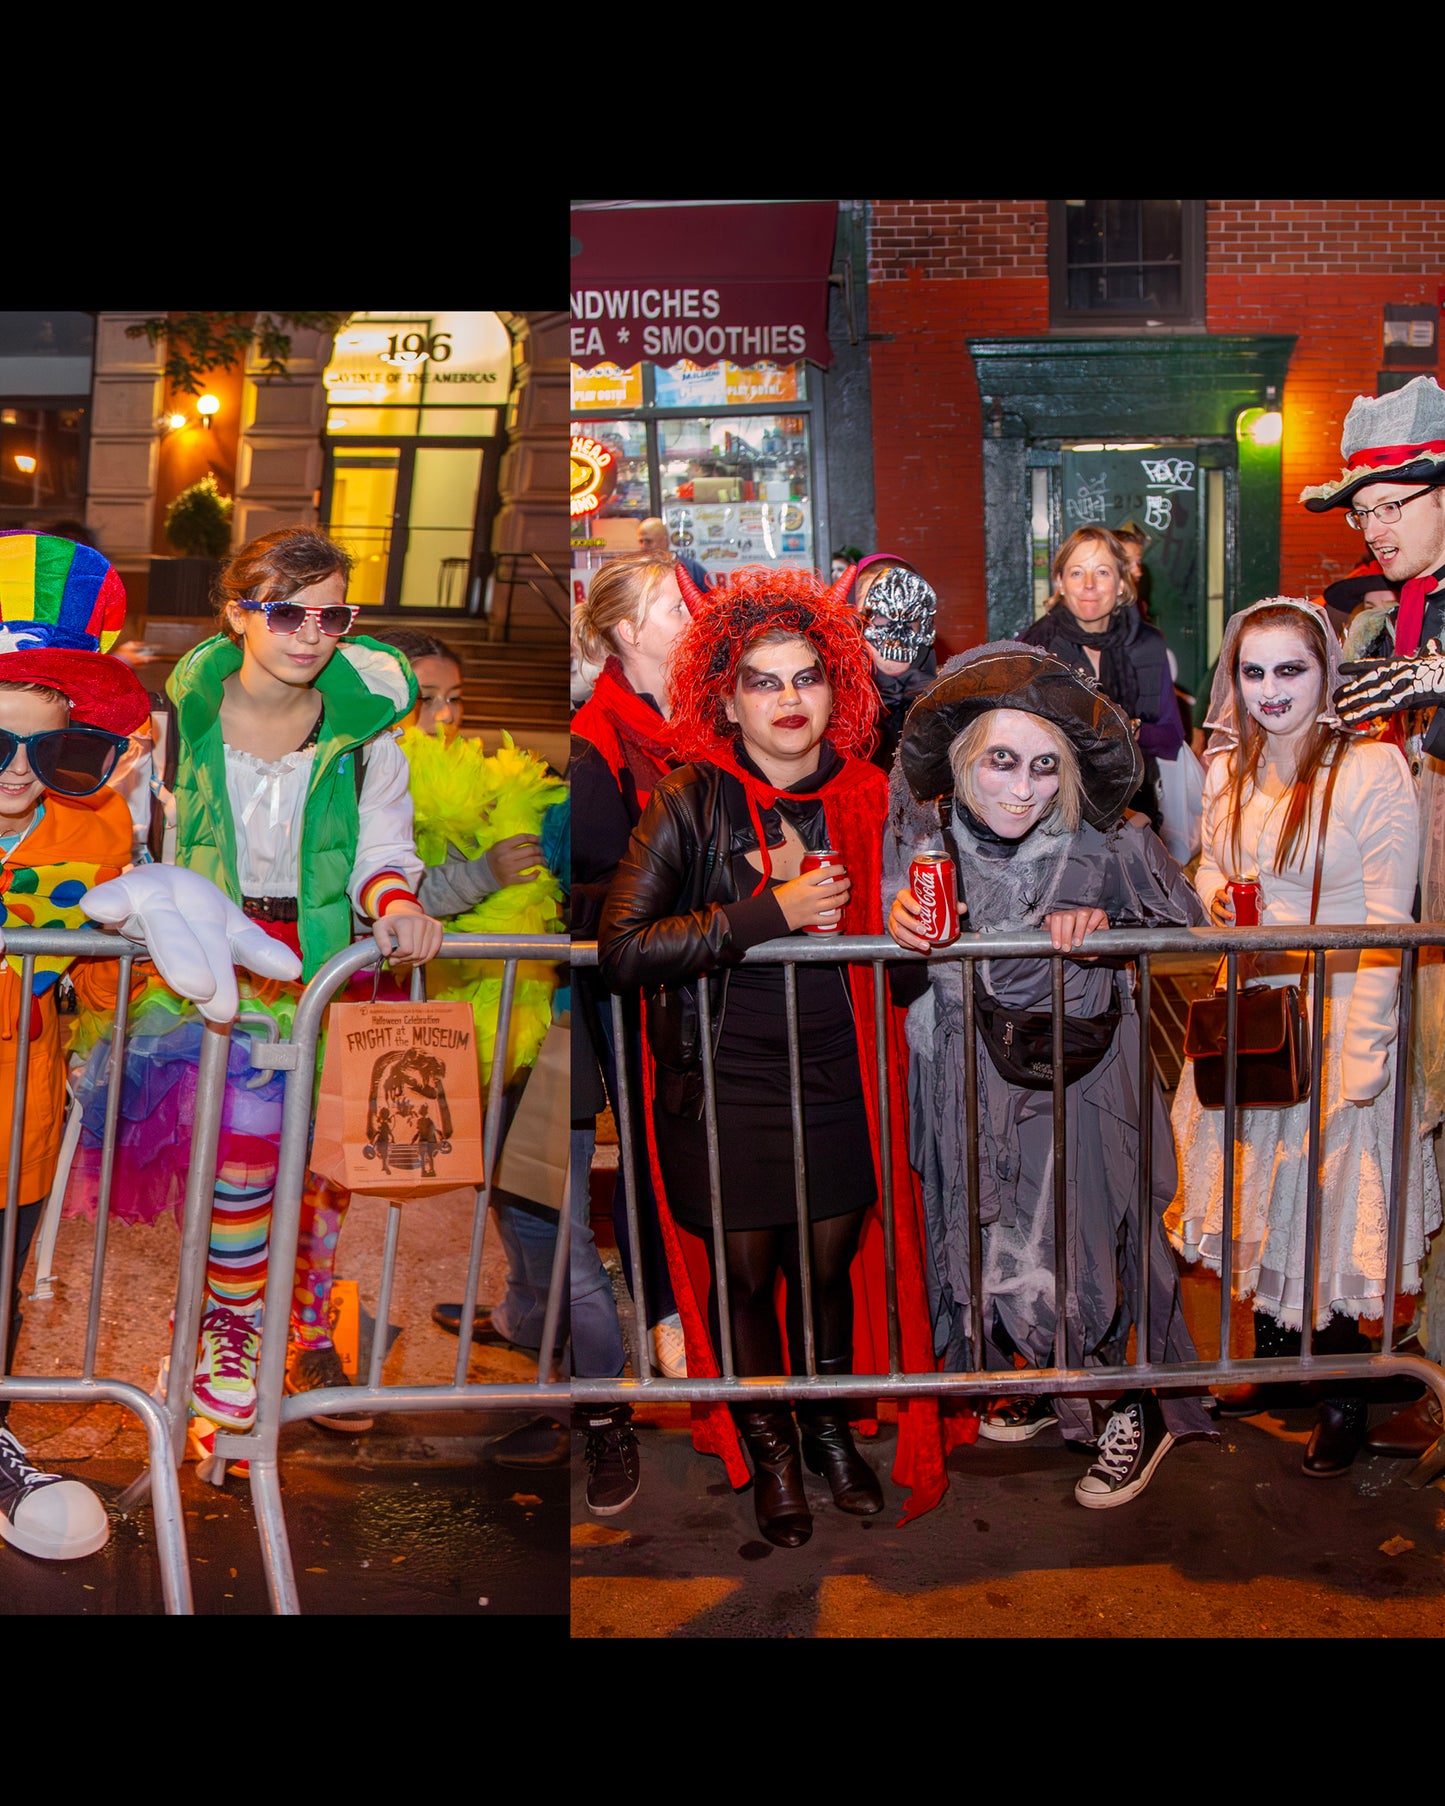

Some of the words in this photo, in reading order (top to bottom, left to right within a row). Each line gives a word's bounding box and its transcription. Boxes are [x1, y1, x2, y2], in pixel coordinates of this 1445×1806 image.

[387, 333, 452, 362] 196
[643, 325, 806, 355] SMOOTHIES
[385, 373, 402, 384] OF
[407, 373, 429, 384] THE
[434, 373, 497, 384] AMERICAS
[572, 437, 612, 467] HEAD
[371, 1016, 402, 1025] Halloween
[403, 1015, 440, 1025] Celebration
[396, 1026, 406, 1036] at
[346, 1027, 392, 1054] FRIGHT
[394, 1037, 409, 1047] the
[412, 1026, 470, 1051] MUSEUM
